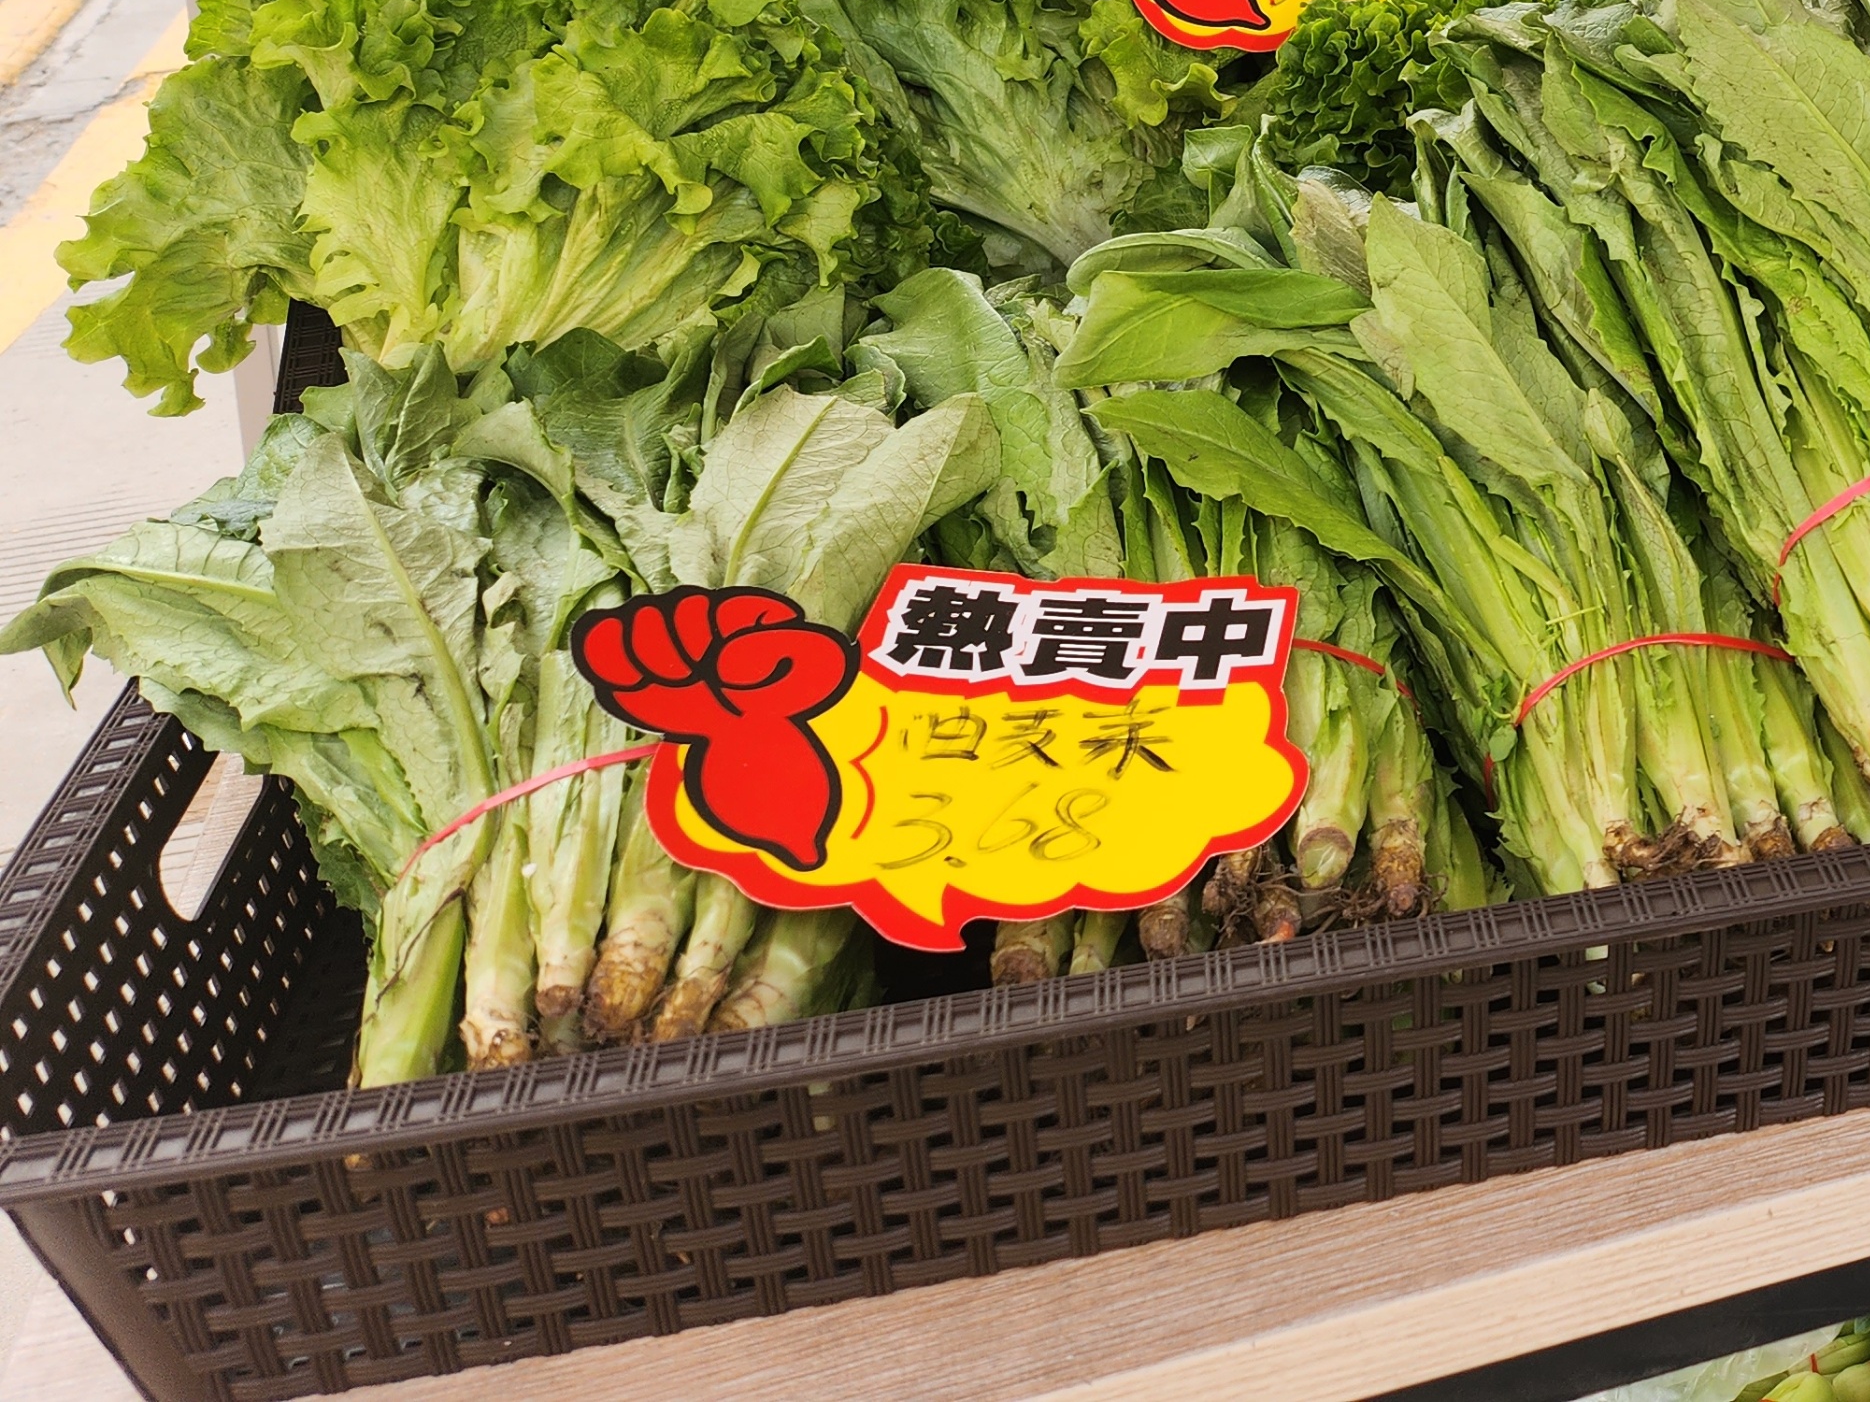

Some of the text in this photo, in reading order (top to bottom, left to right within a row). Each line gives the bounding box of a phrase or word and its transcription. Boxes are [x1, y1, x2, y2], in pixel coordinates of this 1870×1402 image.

[886, 584, 1274, 682] 熱賣中
[874, 781, 1111, 871] 3.68
